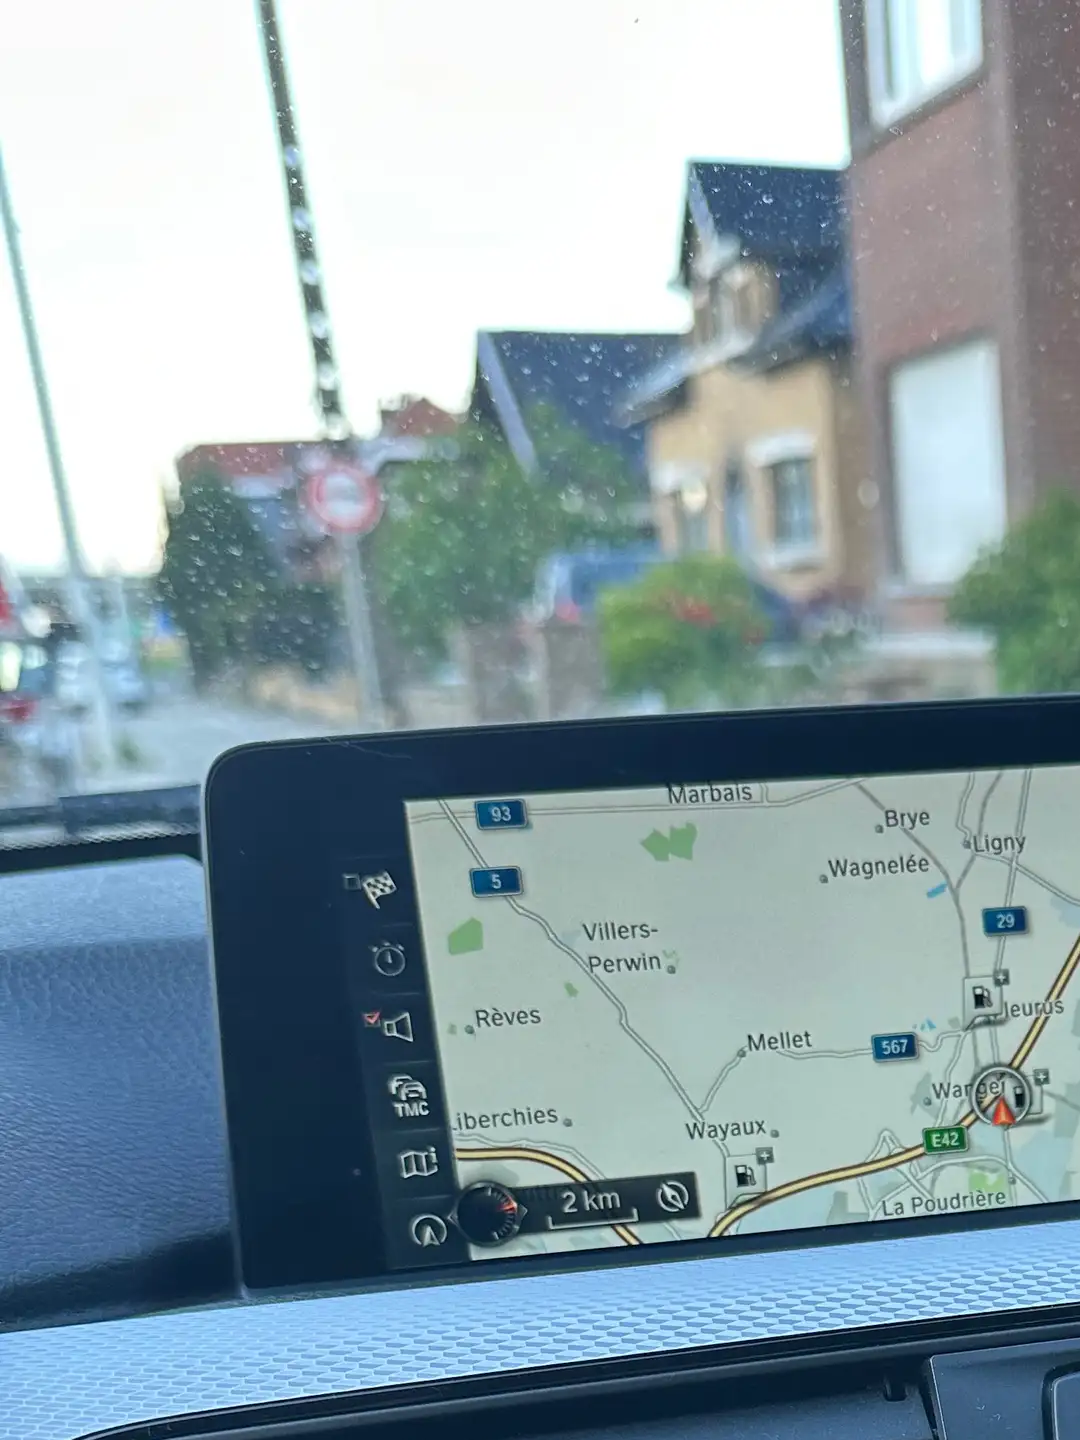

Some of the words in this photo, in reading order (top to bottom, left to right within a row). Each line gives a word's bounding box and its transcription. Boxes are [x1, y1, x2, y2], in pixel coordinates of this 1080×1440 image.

[665, 779, 753, 804] Marbais
[490, 806, 512, 822] 93
[884, 809, 931, 831] Brye
[973, 834, 1026, 854] Ligny
[828, 854, 930, 879] Wagnelée
[492, 875, 502, 890] 5
[996, 912, 1015, 930] 29
[582, 922, 659, 942] Villers-
[588, 952, 662, 974] Perwin
[475, 1008, 541, 1028] Rèves
[1003, 1000, 1065, 1018] leurus
[747, 1031, 812, 1051] Mellet
[881, 1038, 909, 1056] 567
[393, 1101, 430, 1118] TMC
[452, 1106, 559, 1131] iberchies
[685, 1120, 767, 1141] Wayaux
[930, 1132, 960, 1149] E42
[562, 1191, 577, 1214] 2
[582, 1189, 622, 1212] km
[882, 1200, 905, 1217] La
[911, 1190, 1007, 1213] Poudrière
